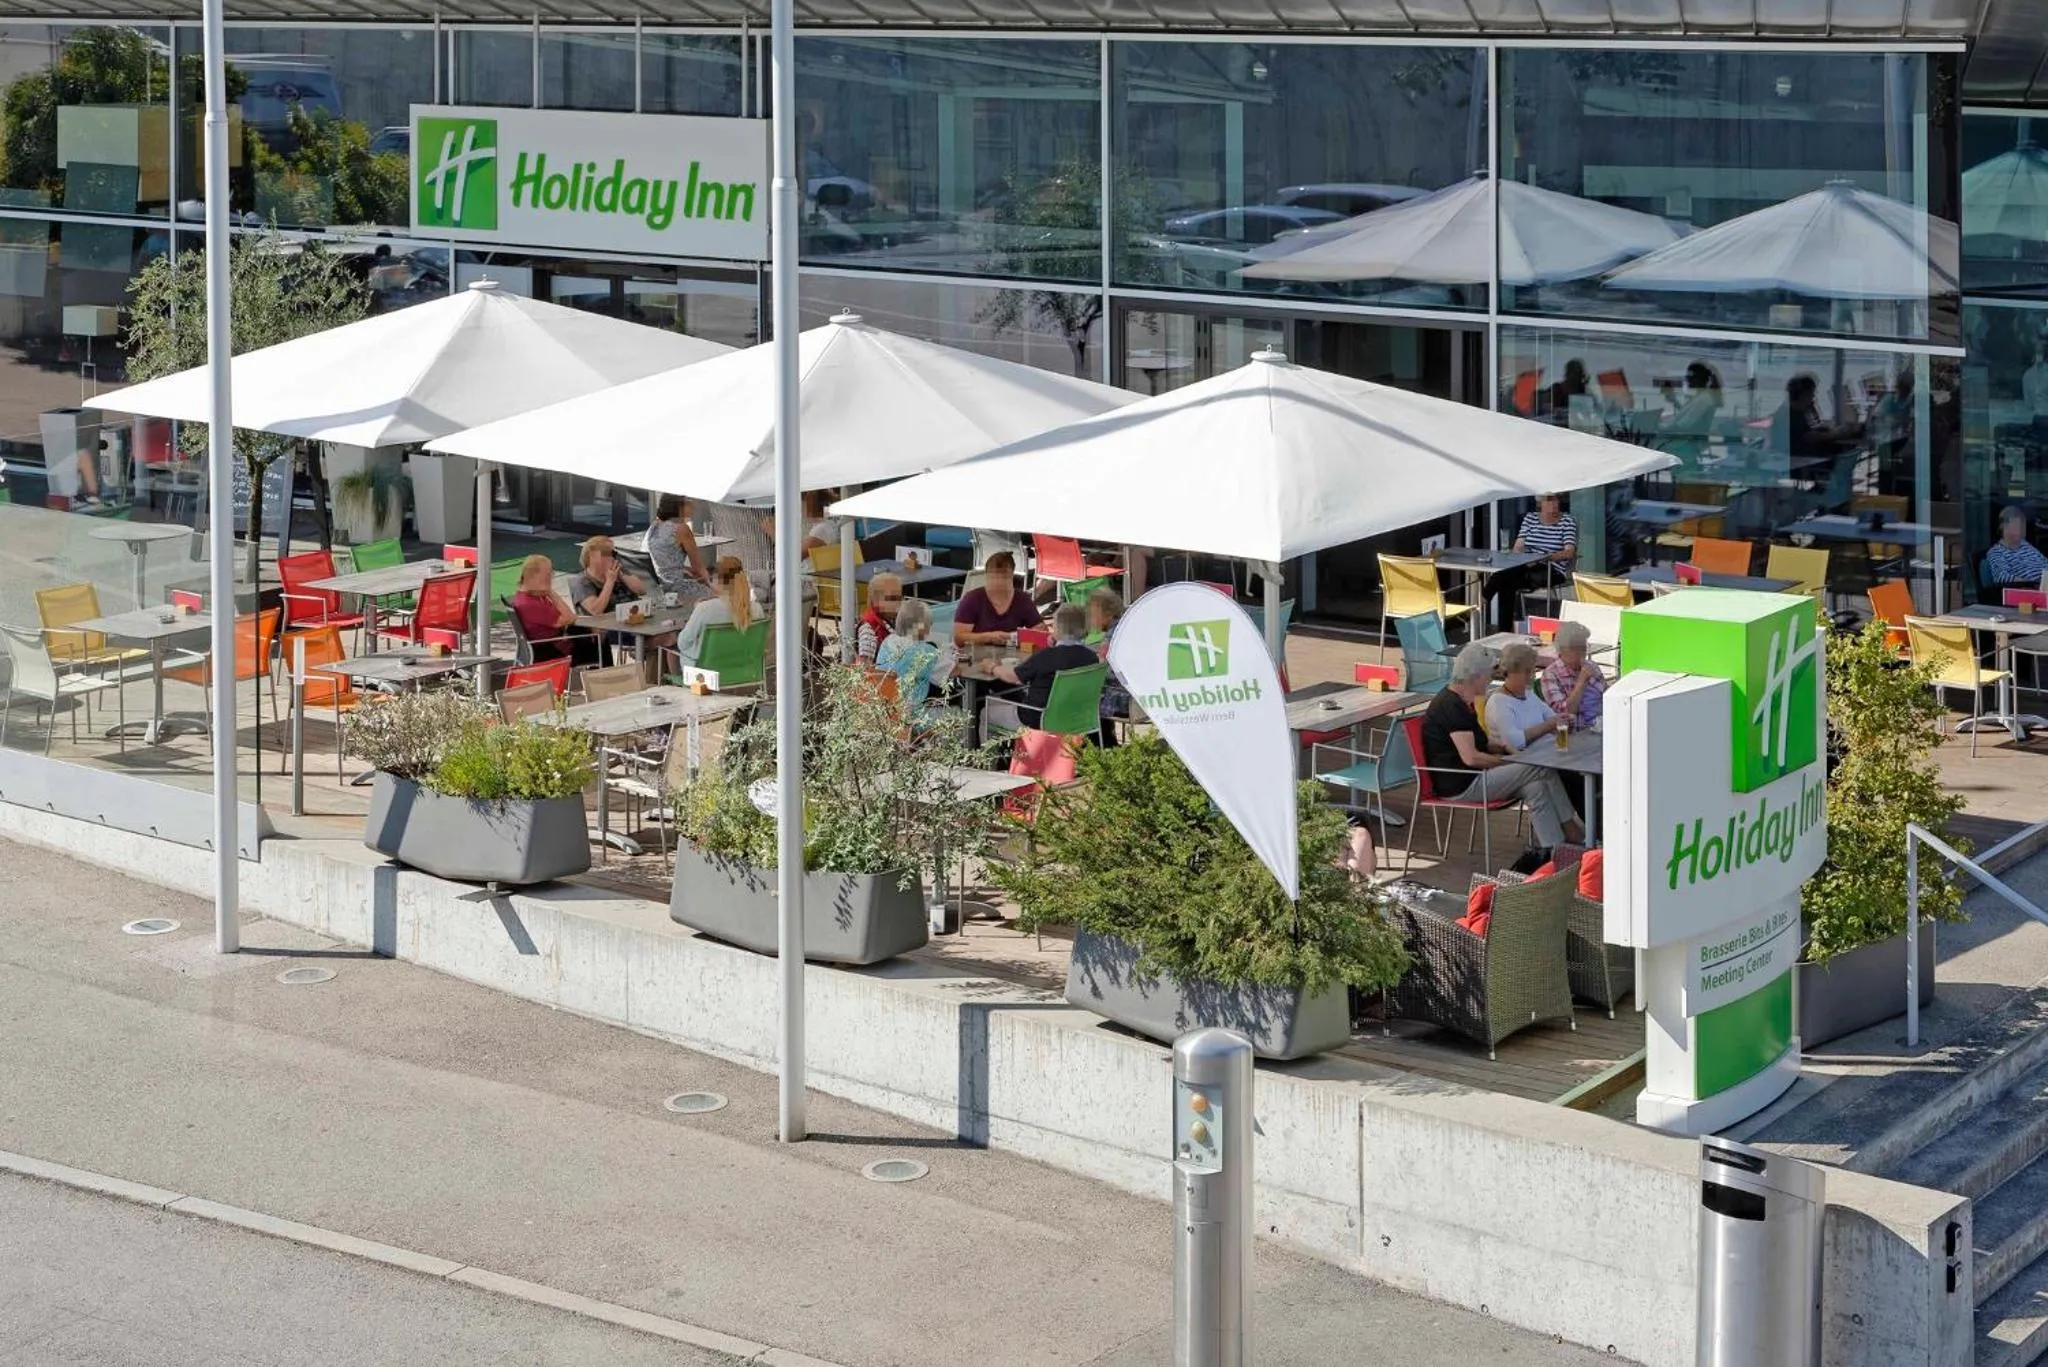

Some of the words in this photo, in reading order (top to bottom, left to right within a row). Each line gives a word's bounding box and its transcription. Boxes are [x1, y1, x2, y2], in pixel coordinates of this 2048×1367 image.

[510, 152, 678, 231] Holiday
[683, 161, 756, 222] Inn
[1666, 797, 1797, 889] Holiday
[1799, 772, 1822, 836] Inn
[1701, 933, 1748, 963] Brasserie
[1749, 925, 1764, 944] Bits
[1701, 967, 1744, 992] Meeting
[1746, 950, 1773, 974] Center
